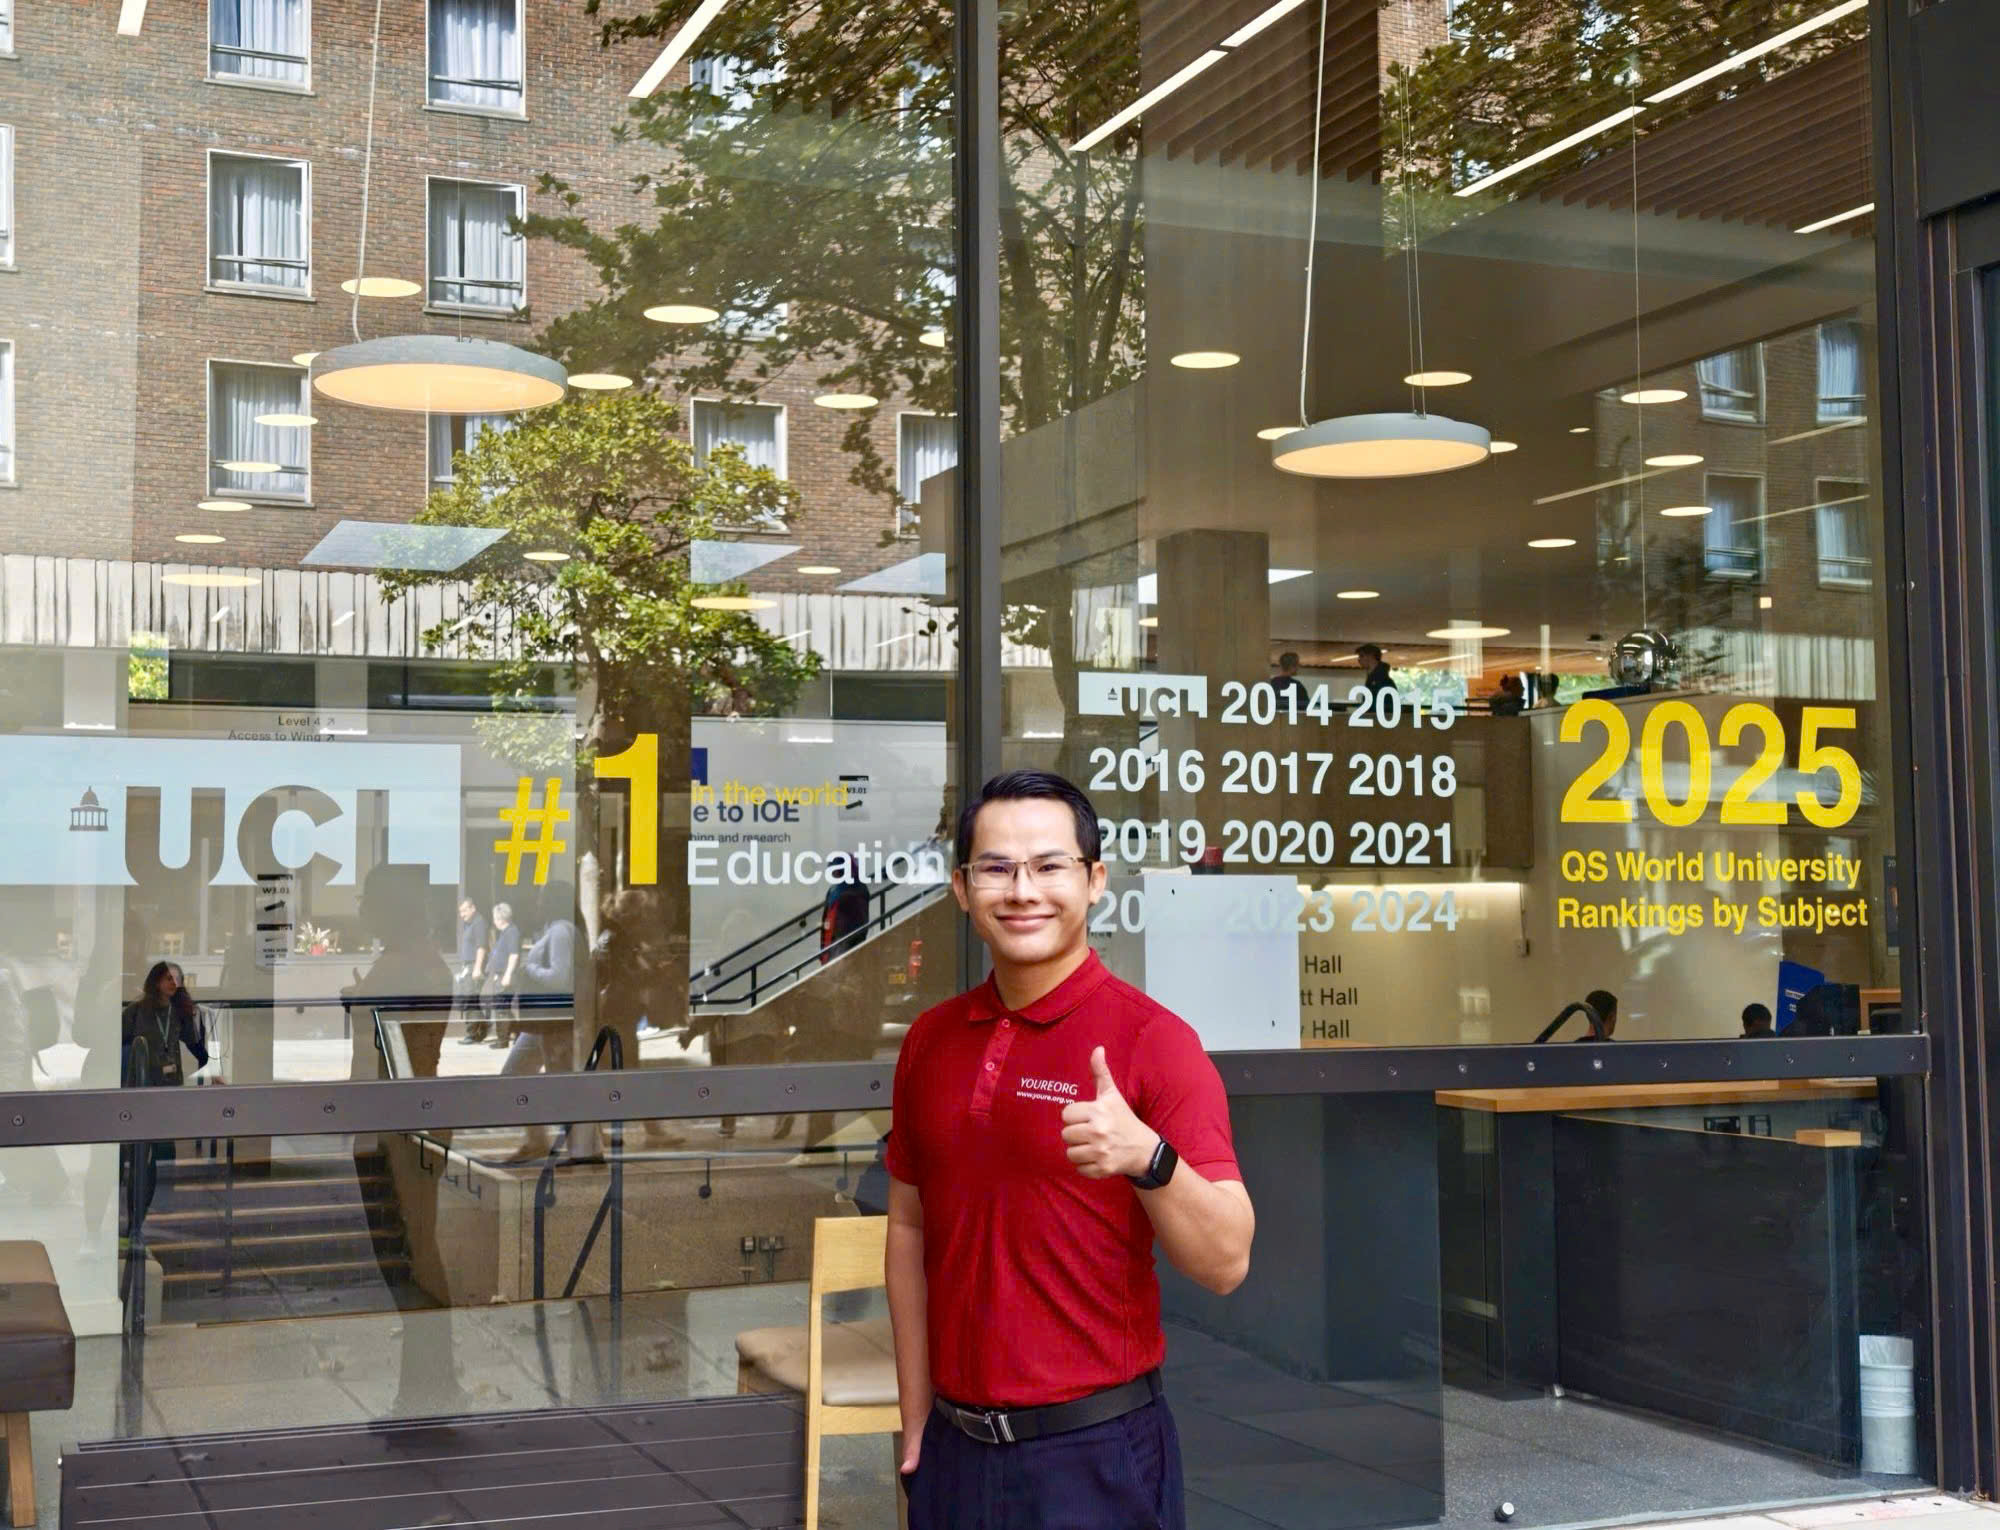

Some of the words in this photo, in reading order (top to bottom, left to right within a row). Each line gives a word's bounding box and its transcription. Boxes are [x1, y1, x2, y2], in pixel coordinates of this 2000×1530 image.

[1121, 686, 1200, 717] UCL
[1221, 681, 1333, 727] 2014
[1347, 685, 1455, 730] 2015
[228, 730, 271, 741] Access
[275, 732, 287, 742] to
[278, 715, 310, 726] Level
[1089, 747, 1205, 793] 2016
[1221, 750, 1333, 796] 2017
[1349, 753, 1457, 797] 2018
[1559, 698, 1862, 828] 2025
[691, 780, 714, 804] in
[724, 779, 766, 805] the
[775, 779, 849, 806] world
[717, 801, 743, 822] to
[753, 799, 800, 822] IOE
[125, 785, 430, 886] UCL
[719, 832, 739, 843] and
[743, 832, 791, 843] research
[1097, 818, 1206, 863] 2019
[1222, 820, 1334, 865] 2020
[1349, 821, 1453, 865] 2021
[687, 840, 945, 886] Education
[1562, 851, 1608, 883] QS
[1616, 851, 1704, 882] World
[1715, 851, 1861, 889] University
[1351, 890, 1458, 932] 2024
[1558, 898, 1704, 935] Rankings
[1713, 899, 1748, 935] by
[1757, 898, 1868, 934] Subject
[1304, 955, 1342, 974] Hall
[1320, 987, 1358, 1006] Hall
[1312, 1019, 1350, 1039] Hall
[1021, 1077, 1078, 1095] YOUREORG
